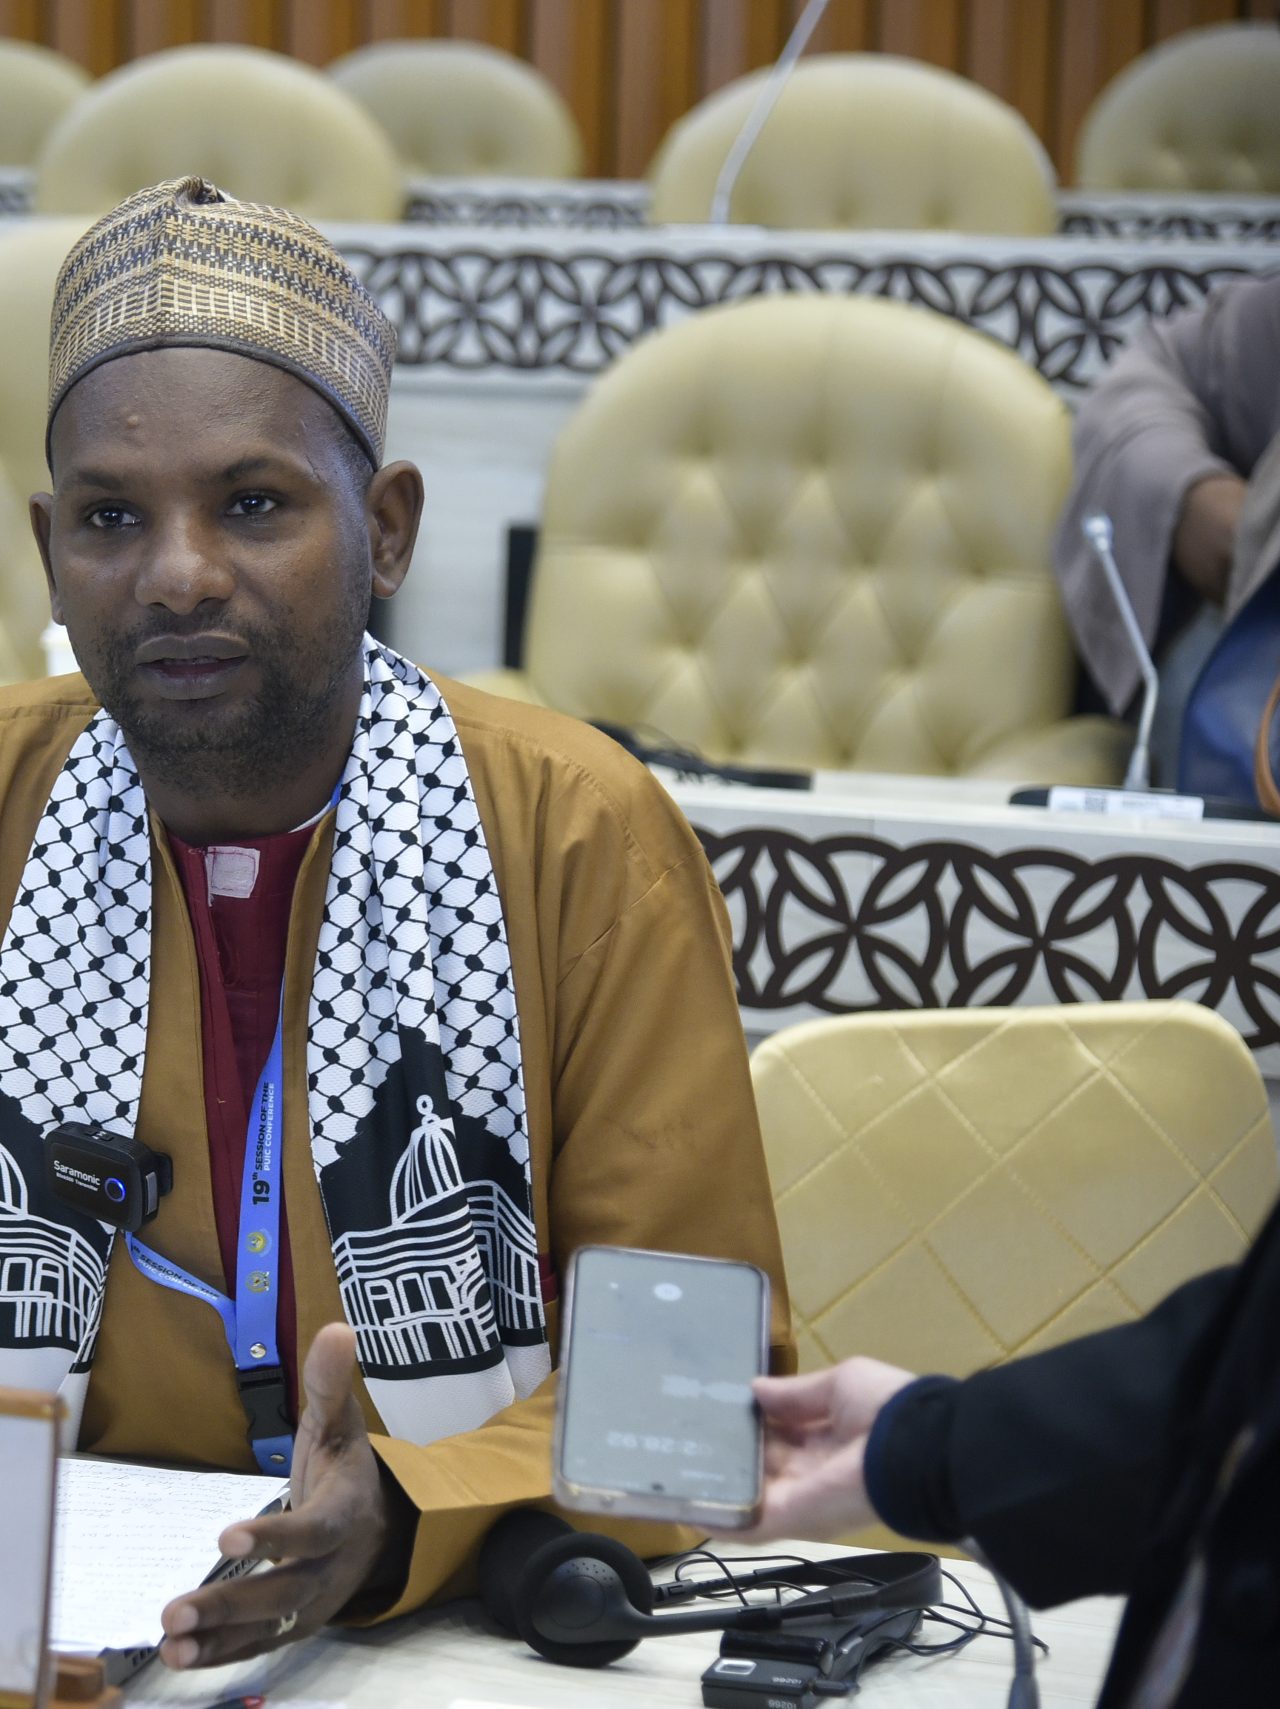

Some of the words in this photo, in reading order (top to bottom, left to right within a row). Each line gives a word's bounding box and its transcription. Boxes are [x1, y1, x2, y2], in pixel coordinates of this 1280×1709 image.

[261, 1082, 269, 1104] THE
[261, 1105, 267, 1121] OF
[264, 1083, 275, 1147] CONFERENCE
[255, 1124, 266, 1171] SESSION
[263, 1149, 272, 1171] PUIC
[53, 1160, 101, 1186] Saramonic
[140, 1254, 182, 1280] SESSION
